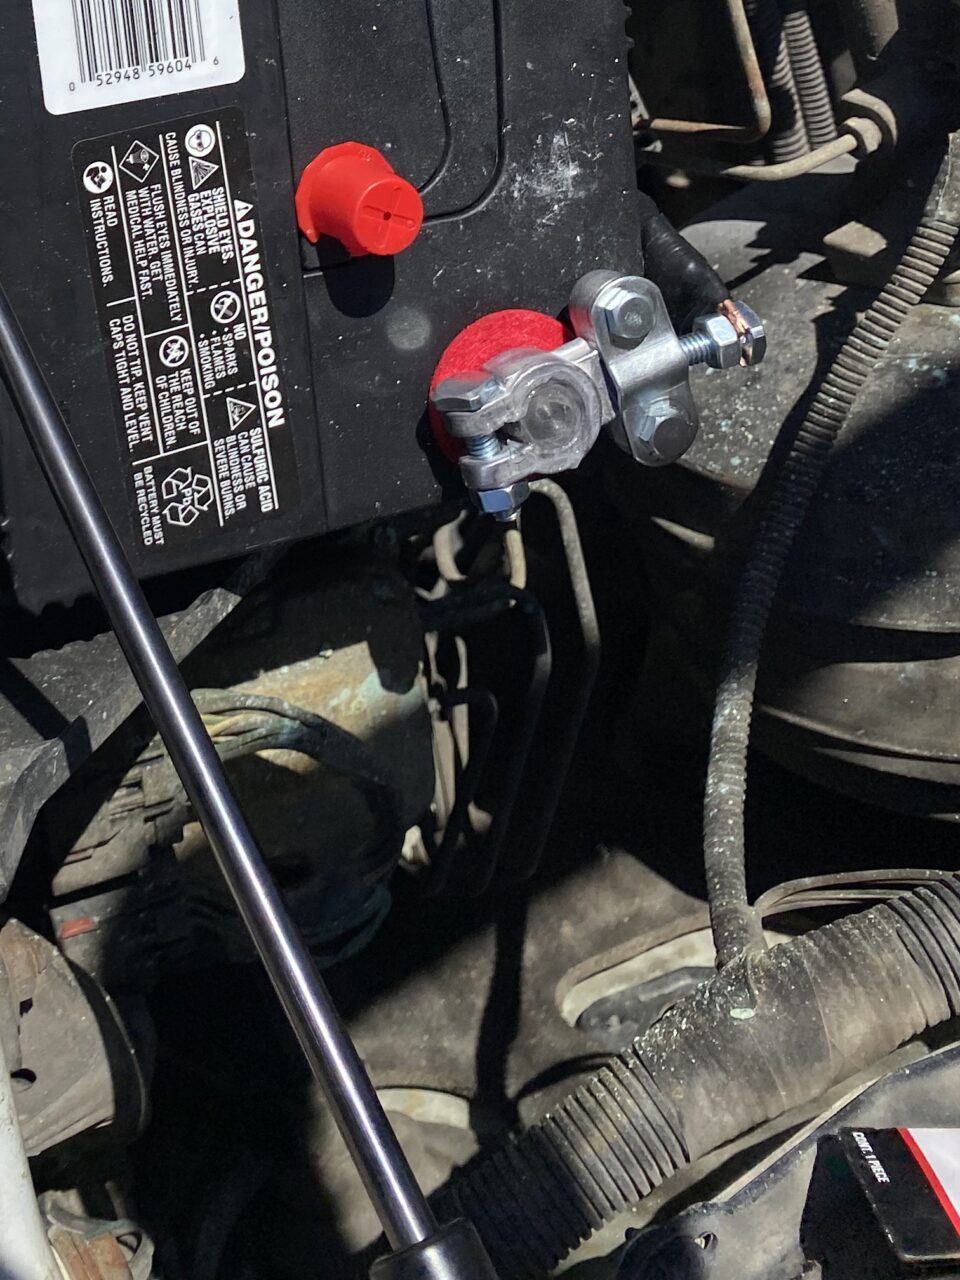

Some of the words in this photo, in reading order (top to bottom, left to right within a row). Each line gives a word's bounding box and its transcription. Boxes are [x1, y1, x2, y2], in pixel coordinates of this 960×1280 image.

[68, 82, 75, 92] 0
[96, 67, 140, 86] 52948
[148, 58, 192, 77] 59604
[212, 56, 218, 65] 6
[164, 131, 180, 167] CAUSE
[103, 195, 117, 227] READ
[125, 189, 143, 238] MEDICAL
[137, 186, 152, 216] WITH
[150, 183, 165, 220] FLUSH
[170, 167, 189, 227] BLINDNESS
[187, 192, 203, 231] GASES
[211, 186, 228, 228] SHIELD
[142, 216, 159, 259] WATER.
[155, 220, 170, 249] EYES
[179, 228, 192, 244] OR
[199, 189, 219, 254] EXPLOSIVE
[89, 198, 113, 287] INSTRUCTIONS.
[132, 239, 147, 268] HELP
[193, 232, 206, 255] CAN
[217, 228, 234, 264] EYES.
[137, 269, 152, 300] FAST.
[148, 260, 162, 282] GET
[182, 246, 198, 288] INJURY.
[160, 250, 181, 322] IMMEDIATELY
[109, 317, 124, 349] CAPS
[121, 314, 134, 332] DO
[232, 322, 246, 340] NO
[236, 218, 285, 428] DANGER/POISON
[125, 333, 139, 357] NOT
[210, 336, 225, 379] FLAMES
[222, 333, 237, 375] SPARKS
[114, 350, 129, 385] TIGHT
[129, 358, 142, 380] TIP.
[167, 370, 180, 393] THE
[180, 367, 194, 396] KEEP
[197, 339, 215, 389] SMOKING
[119, 385, 134, 411] AND
[132, 381, 147, 411] KEEP
[155, 374, 167, 390] OF
[158, 391, 176, 449] CHILDREN.
[171, 394, 186, 431] REACH
[184, 396, 197, 420] OUT
[123, 412, 140, 452] LEVEL.
[137, 411, 152, 443] VENT
[188, 420, 200, 436] OF
[237, 431, 250, 453] CAN
[213, 438, 229, 479] SEVERE
[225, 434, 243, 493] BLINDNESS
[234, 493, 246, 510] OR
[241, 456, 255, 489] CAUSE
[249, 427, 268, 483] SULFURIC
[133, 472, 144, 488] BE
[181, 487, 193, 505] Pb
[257, 483, 273, 512] ACID
[143, 465, 159, 515] BATTERY
[151, 515, 164, 546] MUST
[219, 479, 235, 519] BURNS.
[136, 490, 153, 546] RECYCLED
[852, 1131, 874, 1155] CONT.
[868, 1160, 890, 1183] PIECE
